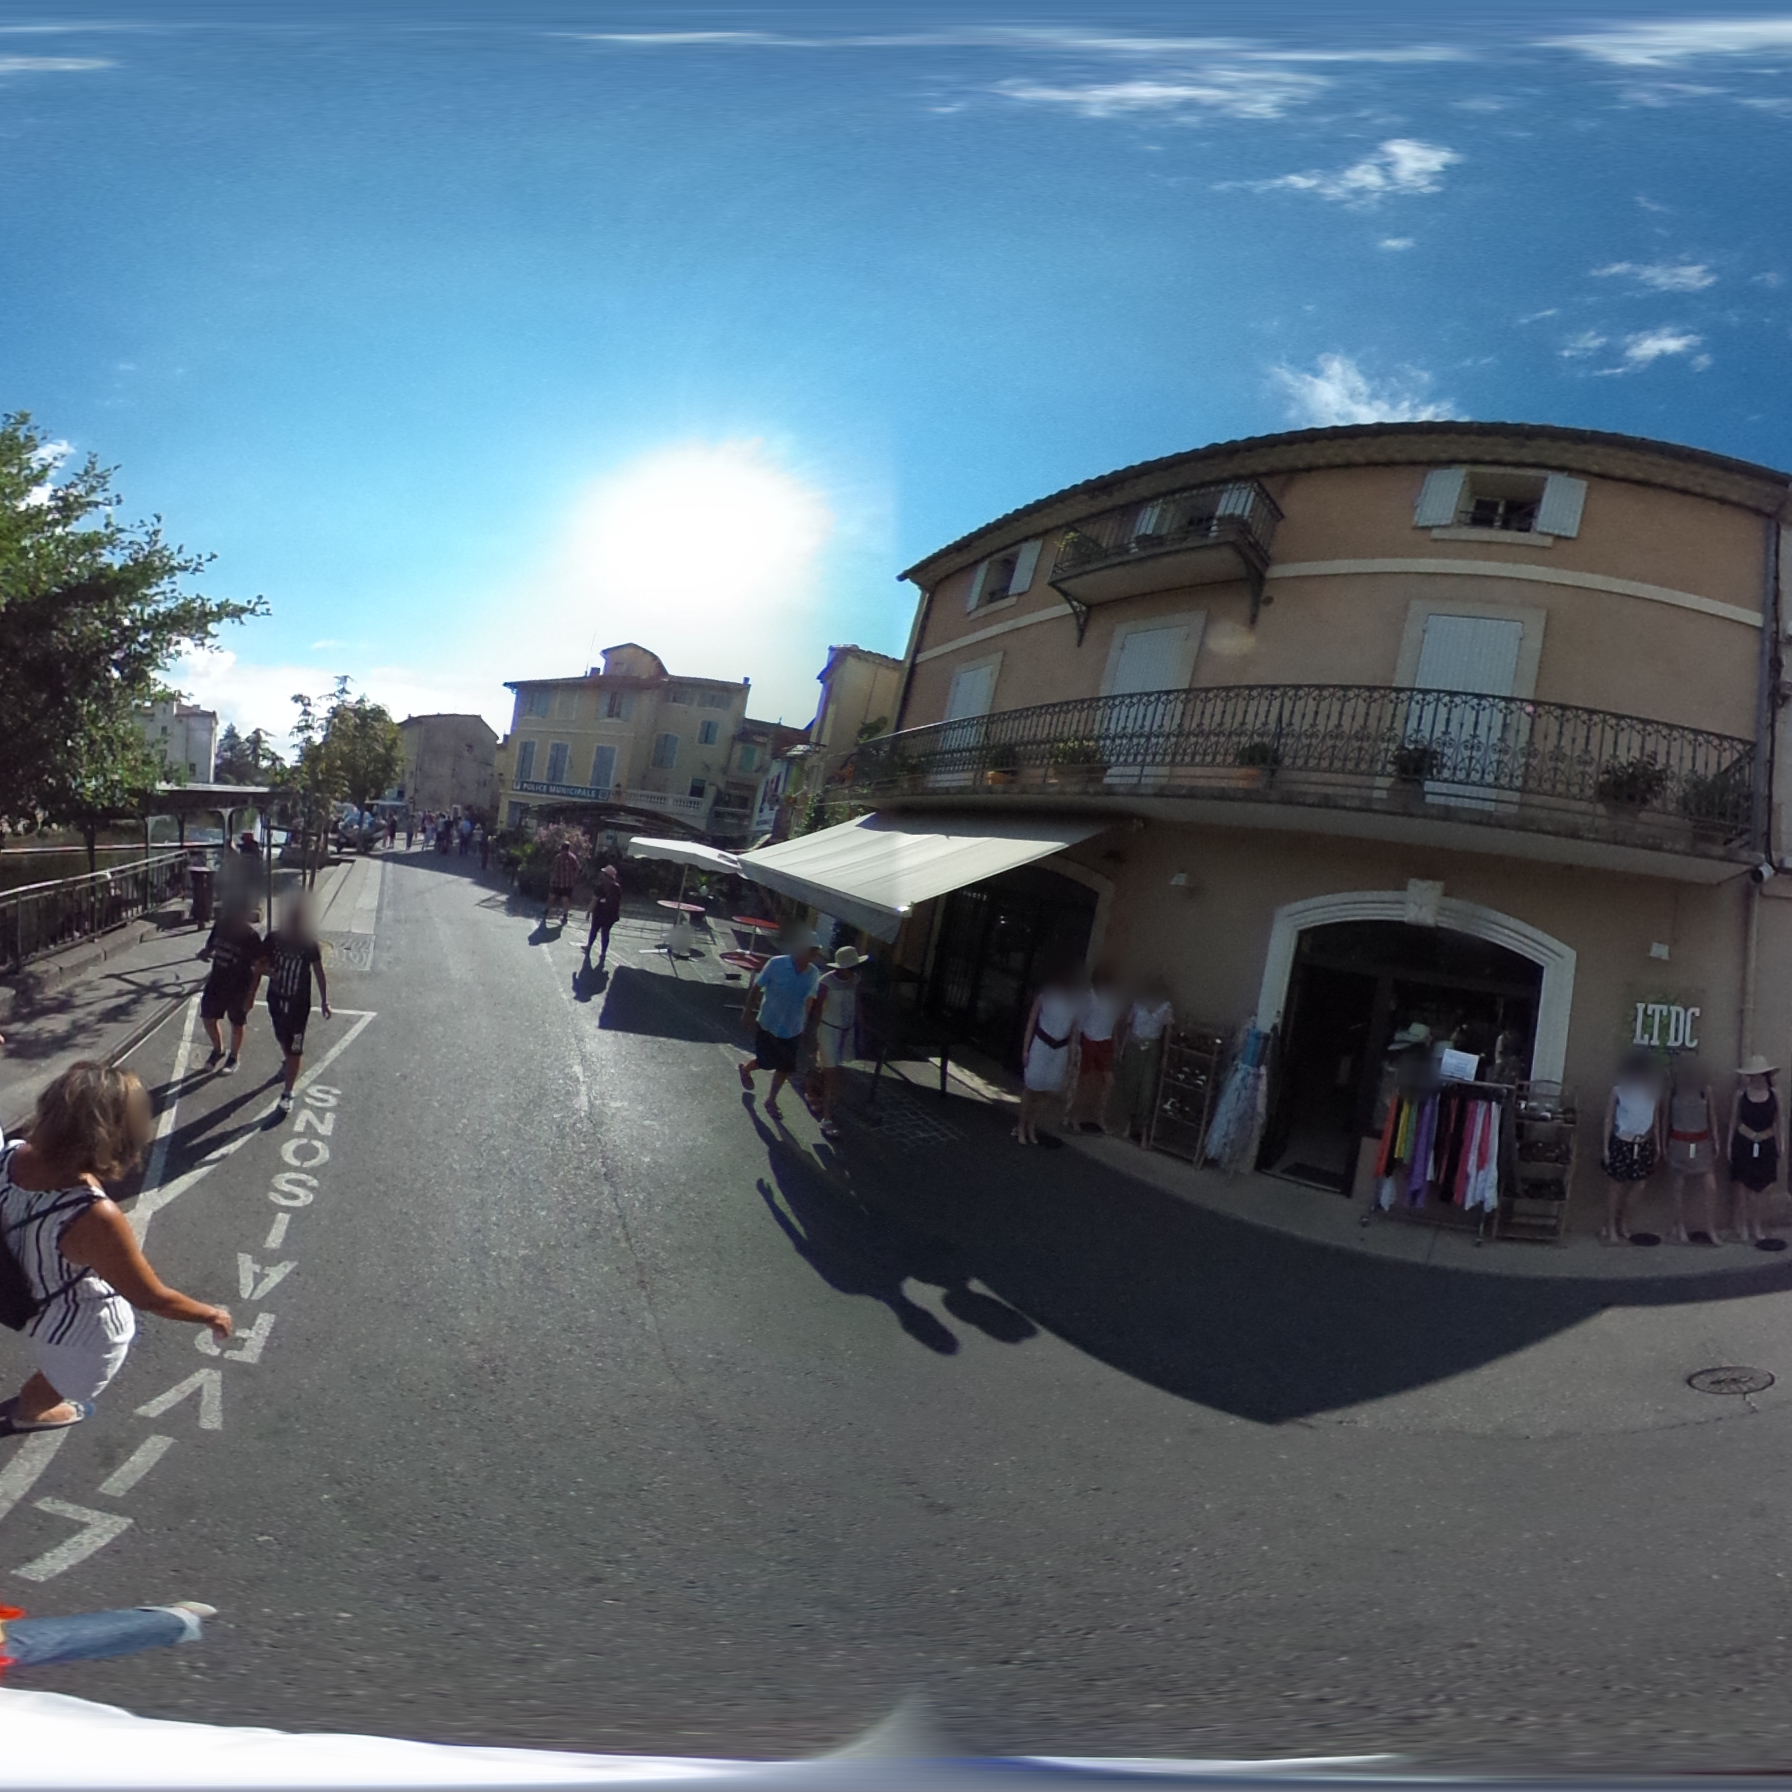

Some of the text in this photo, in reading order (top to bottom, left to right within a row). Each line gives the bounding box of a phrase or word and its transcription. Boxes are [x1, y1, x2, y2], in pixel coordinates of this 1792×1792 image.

[523, 783, 596, 798] POLICE MUNICIPALE
[1633, 1003, 1700, 1048] LTDC
[10, 1084, 342, 1582] LIVRAISONS
